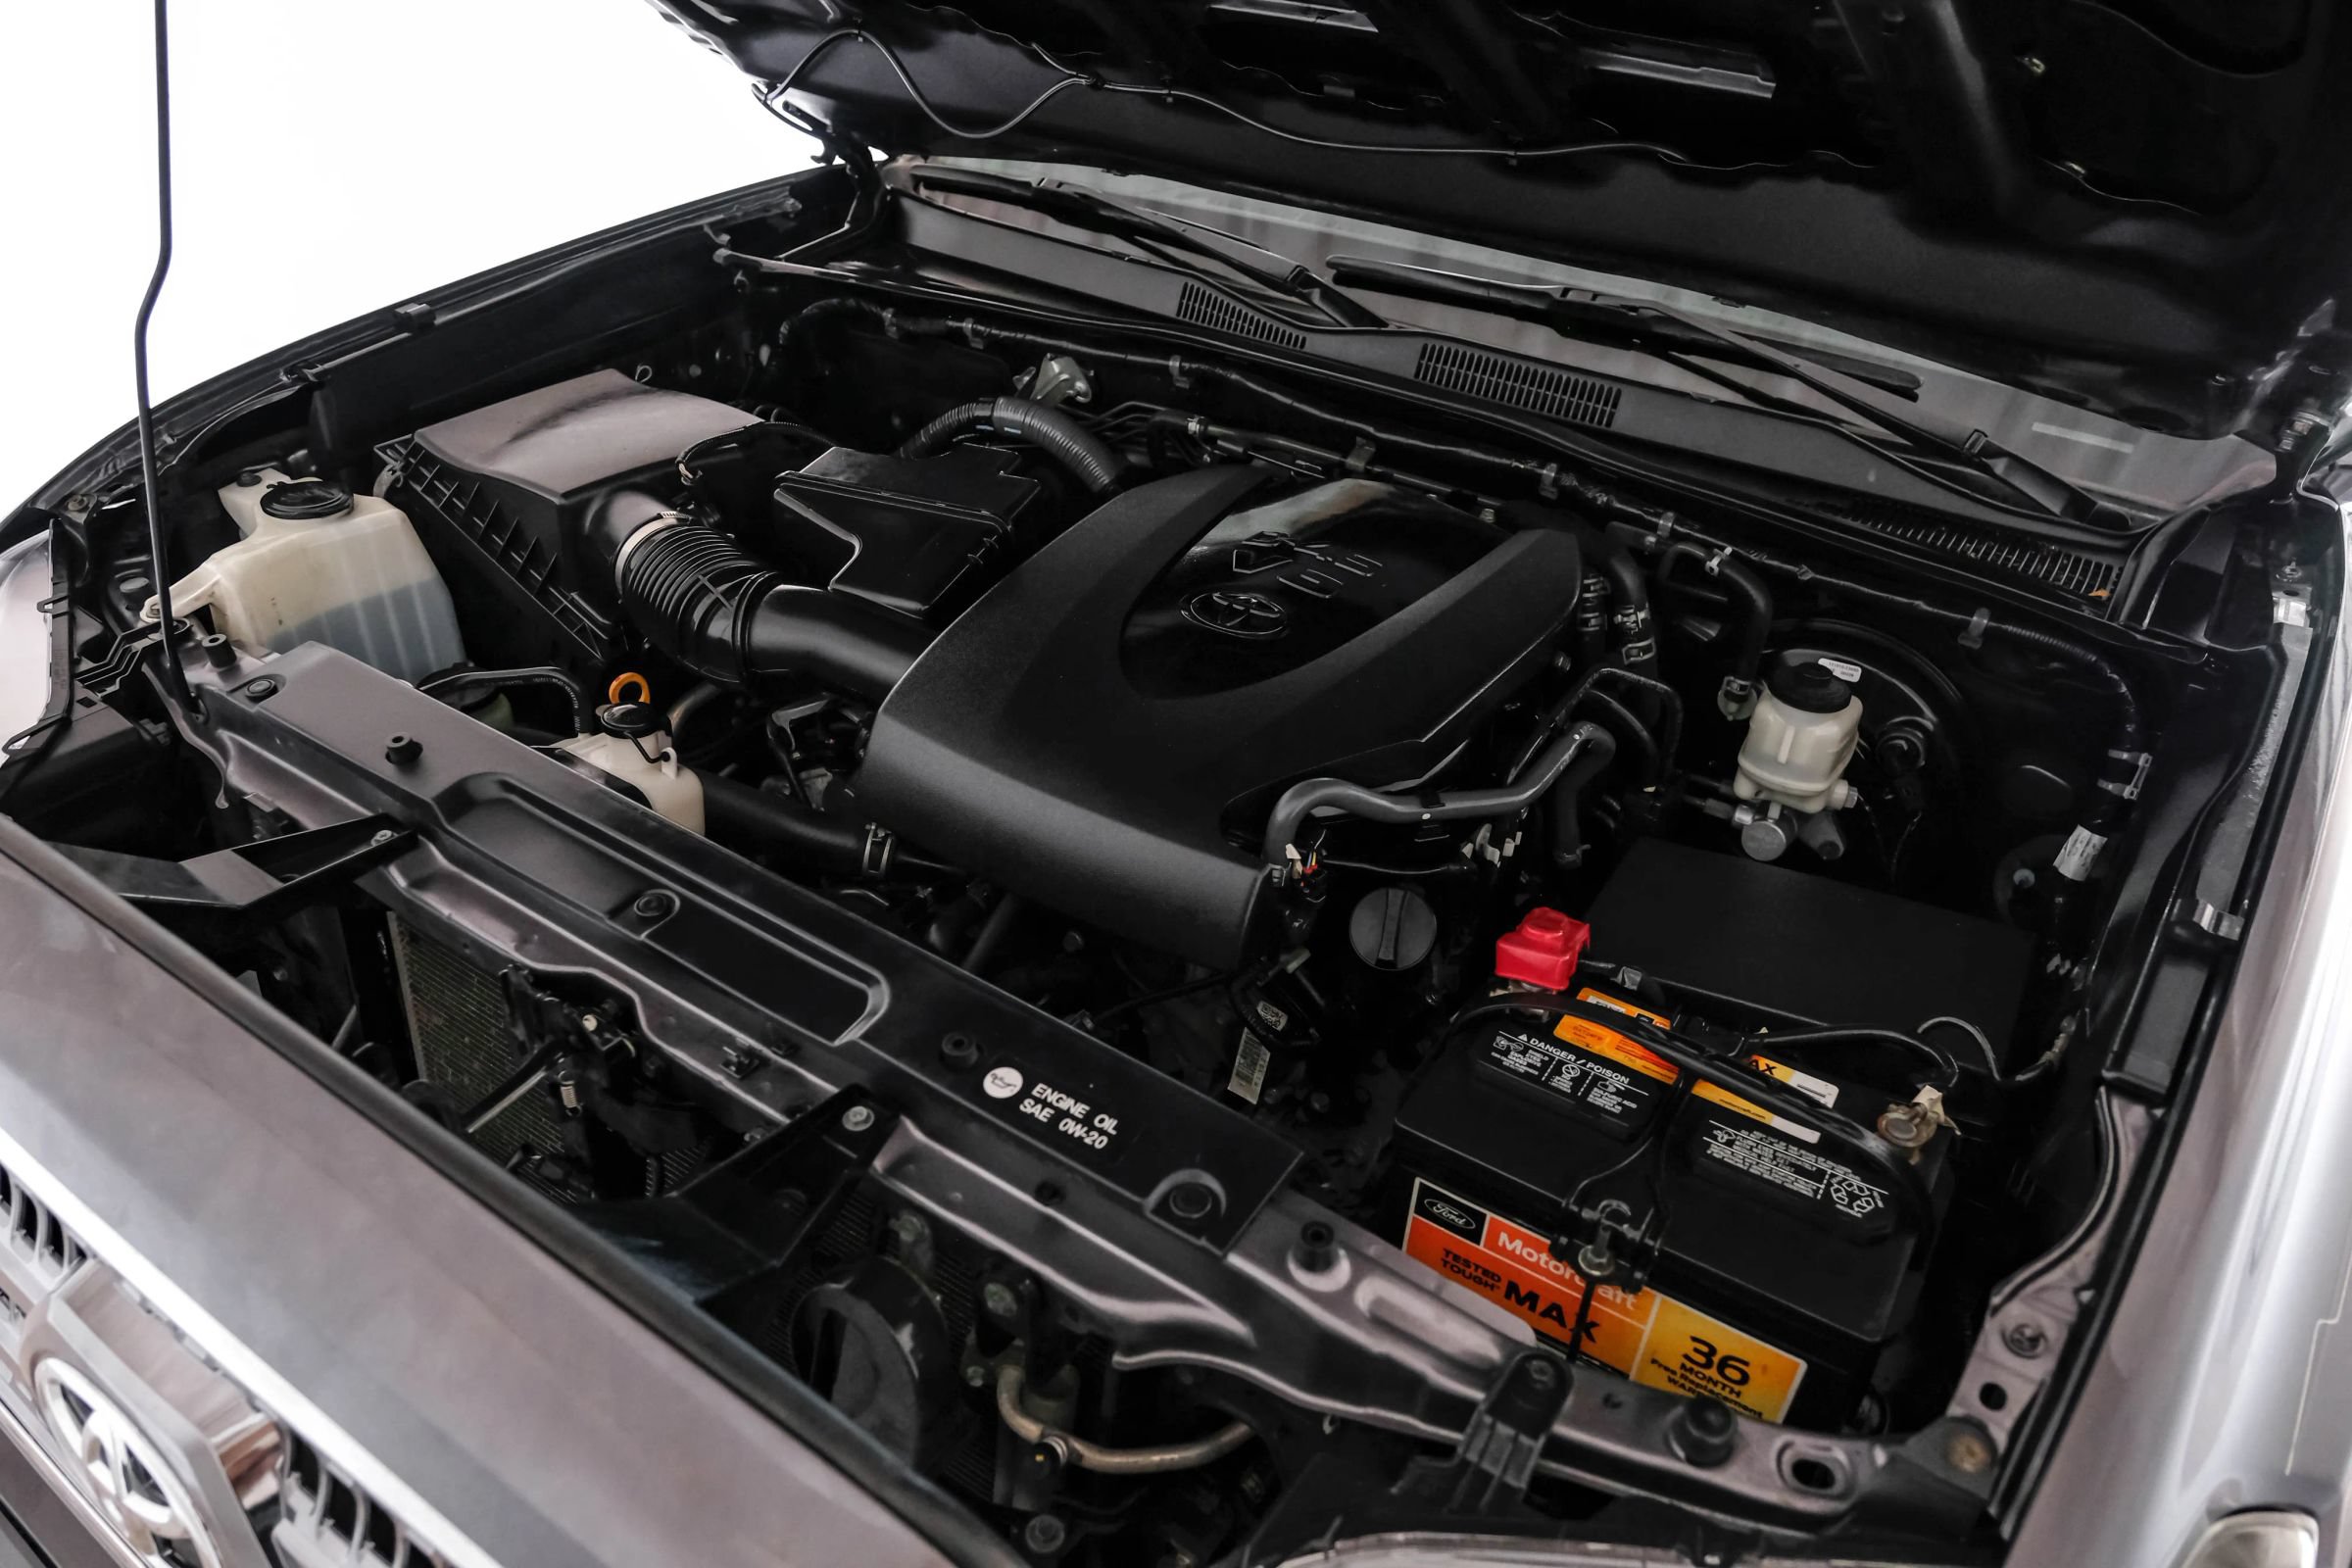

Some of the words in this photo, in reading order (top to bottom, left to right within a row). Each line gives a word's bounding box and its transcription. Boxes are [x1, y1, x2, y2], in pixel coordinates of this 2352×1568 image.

[1529, 1037, 1577, 1062] DANGER
[1586, 1061, 1631, 1085] POISON
[1749, 1059, 1777, 1076] AX
[1019, 1098, 1055, 1123] SAE
[1058, 1117, 1109, 1150] 0W-20
[1031, 1082, 1091, 1119] ENGINE
[1093, 1113, 1118, 1135] OIL
[1433, 1202, 1467, 1226] Ford
[1443, 1248, 1502, 1283] TESTED
[1497, 1231, 1638, 1311] Motorcaft
[1680, 1362, 1741, 1398] MONTH
[1682, 1335, 1750, 1387] 36
[1650, 1358, 1678, 1376] Free
[1679, 1373, 1763, 1419] Replacement
